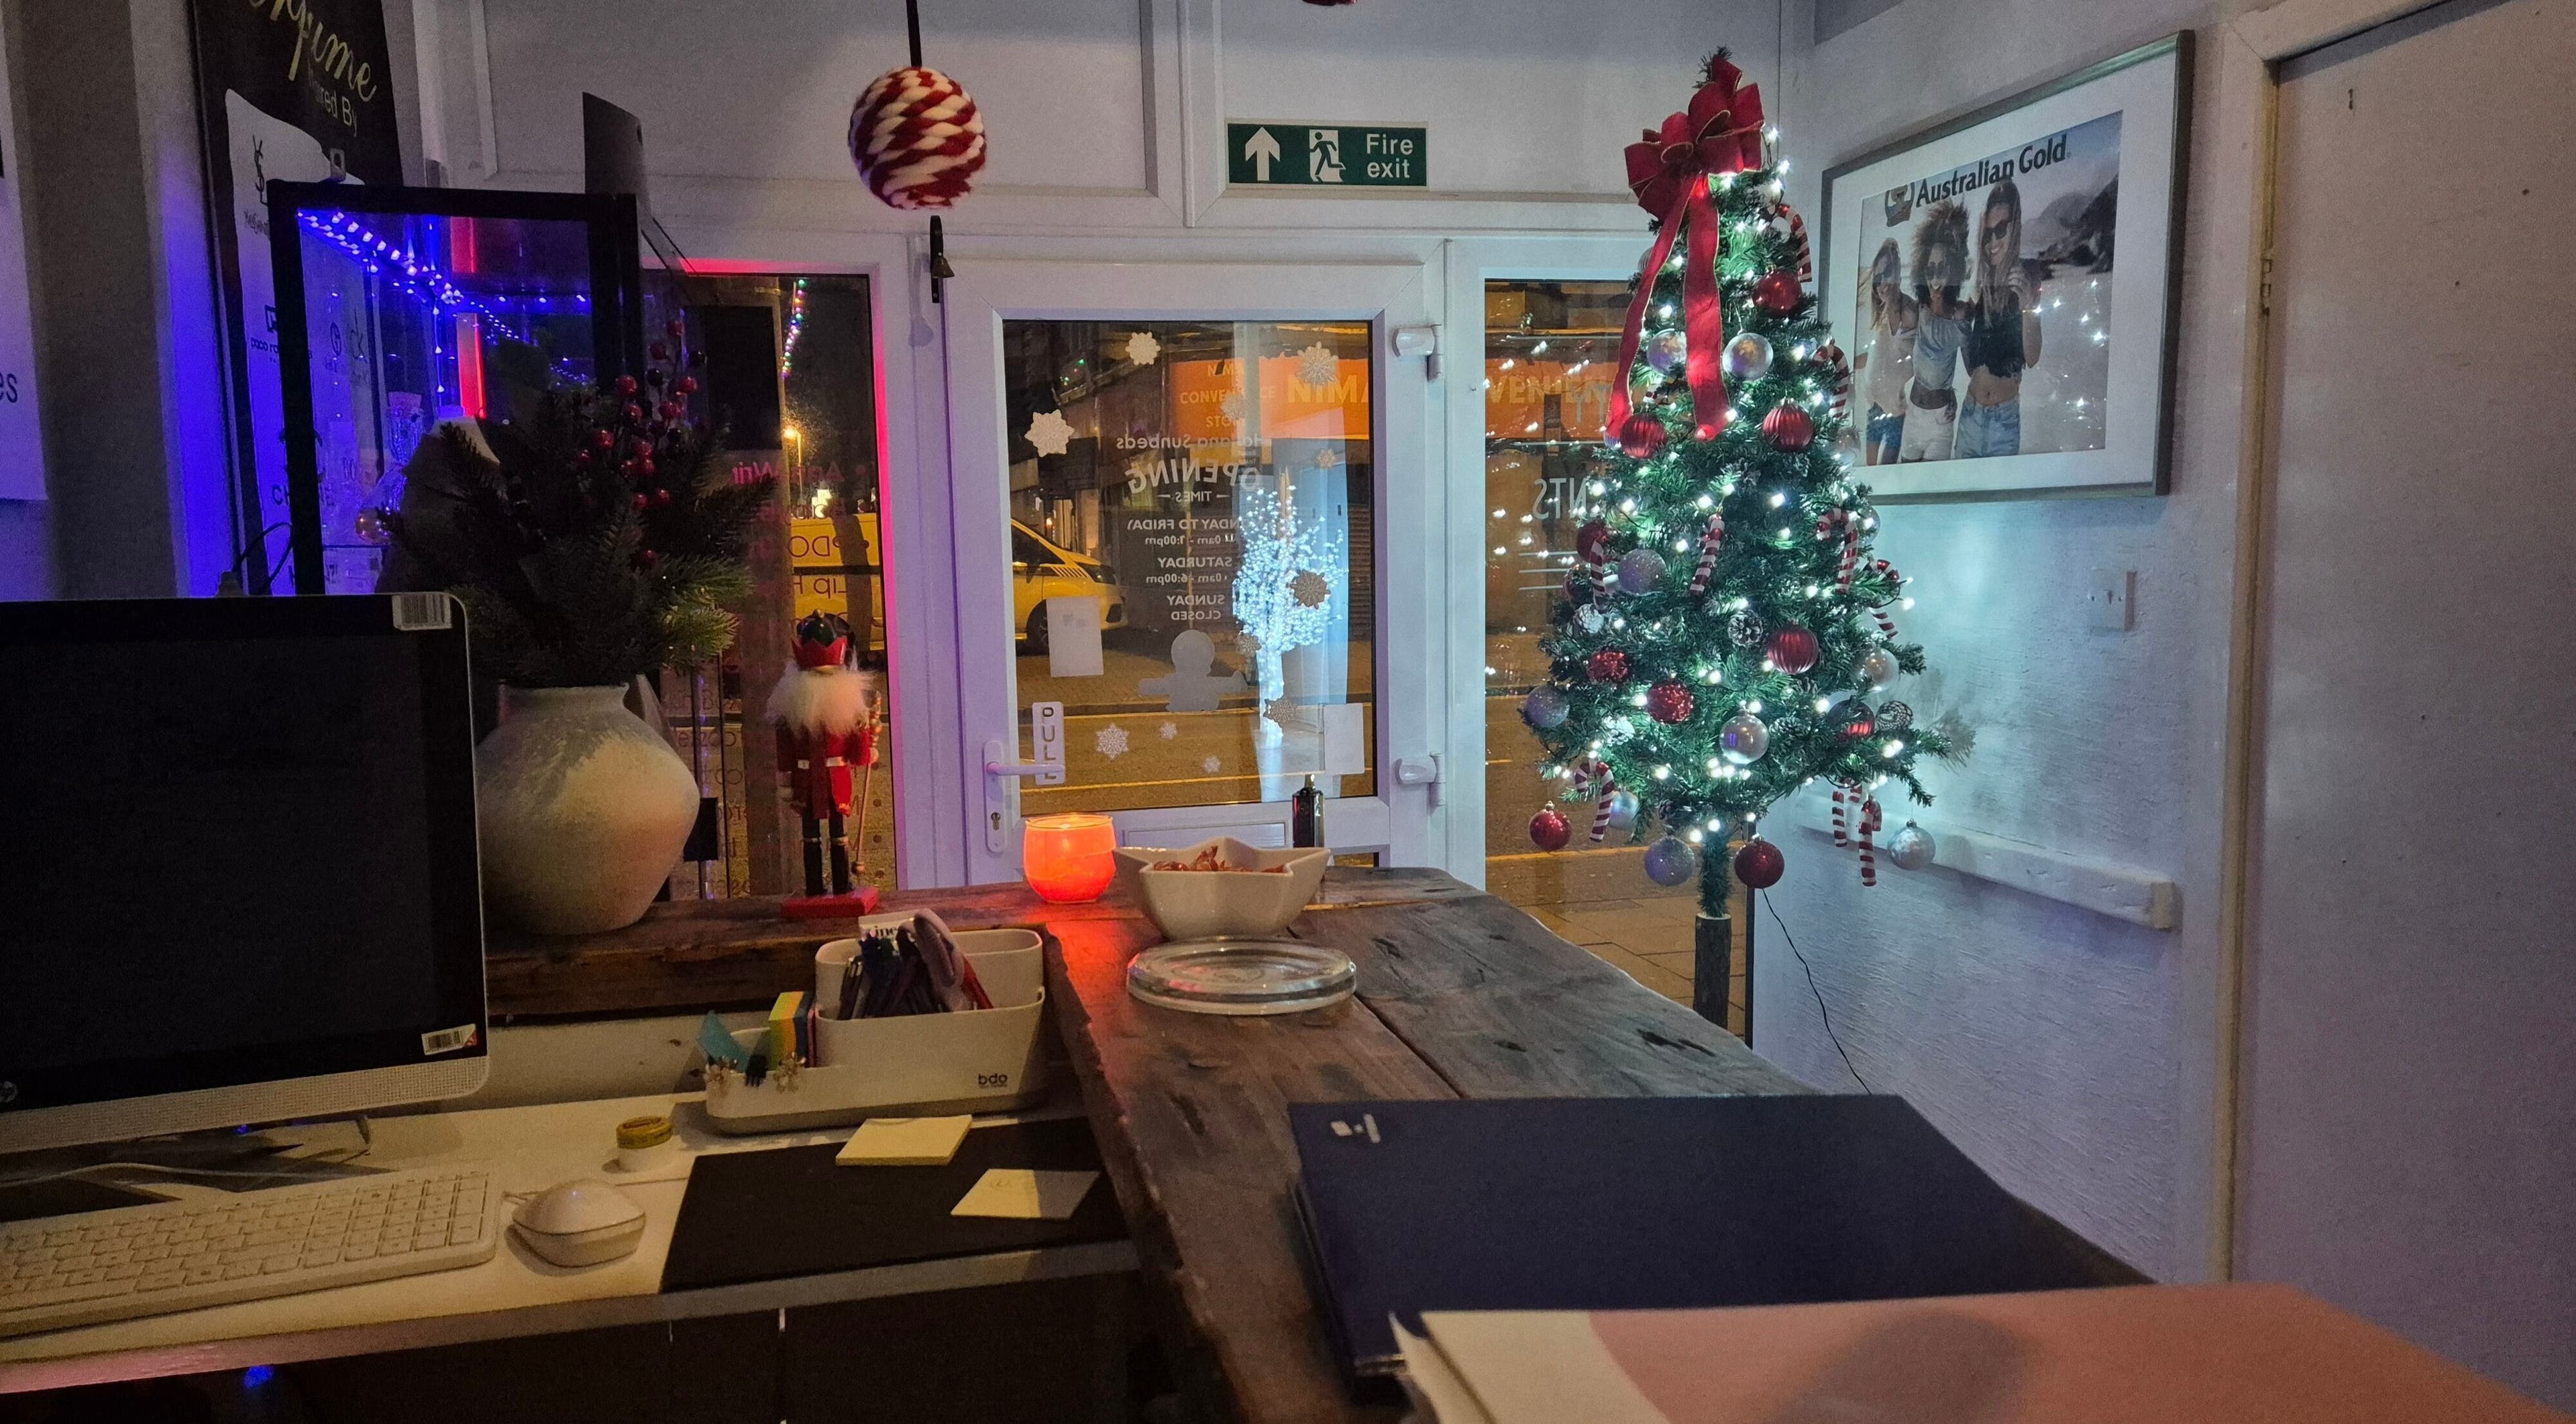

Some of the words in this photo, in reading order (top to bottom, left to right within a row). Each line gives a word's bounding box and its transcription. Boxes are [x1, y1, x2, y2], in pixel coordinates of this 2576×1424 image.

[1366, 133, 1413, 155] Fire
[1366, 158, 1411, 179] exit
[1916, 157, 2014, 208] Australian
[2019, 133, 2068, 174] Gold
